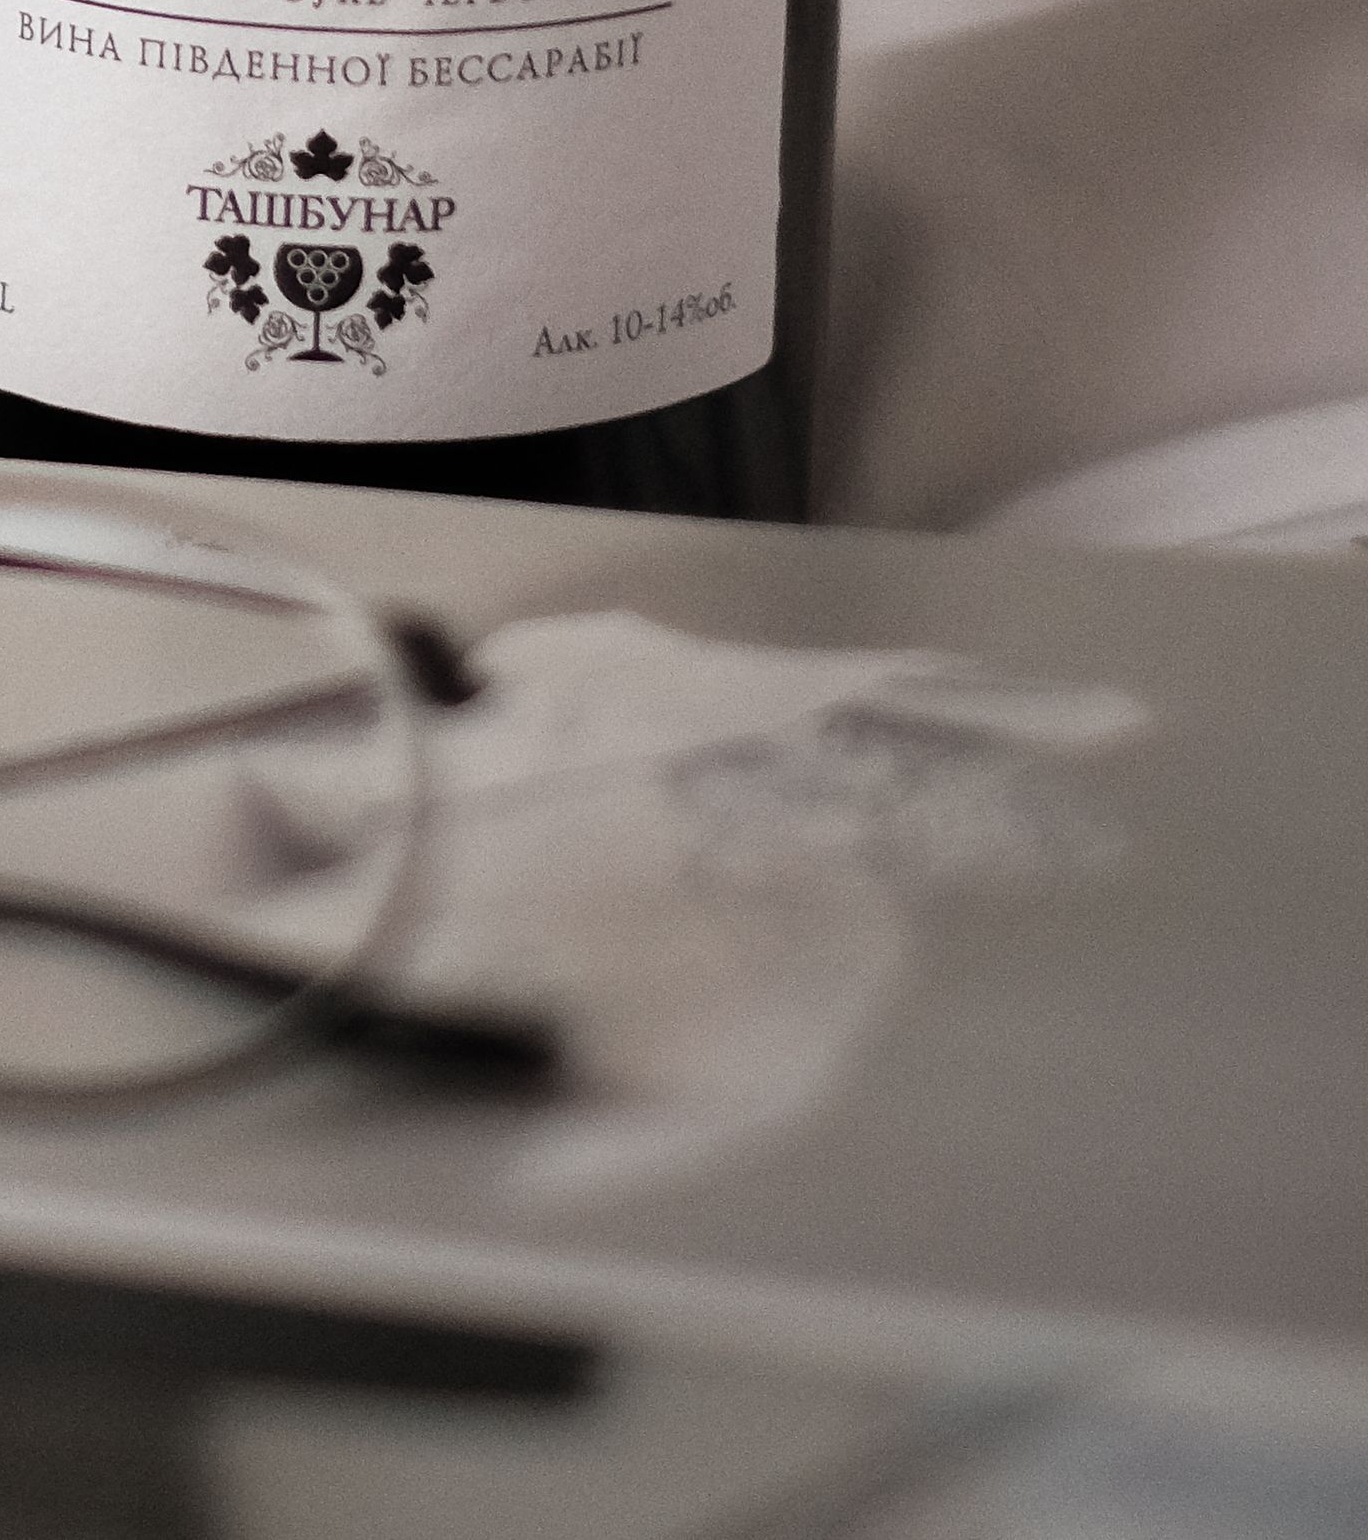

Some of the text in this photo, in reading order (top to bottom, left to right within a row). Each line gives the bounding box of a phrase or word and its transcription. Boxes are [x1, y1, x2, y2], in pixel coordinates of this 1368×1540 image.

[17, 11, 643, 89] ВИНА ПІВДЕННОЇ БЕССАРАБІЇ
[186, 183, 457, 233] ТАШБУНАР
